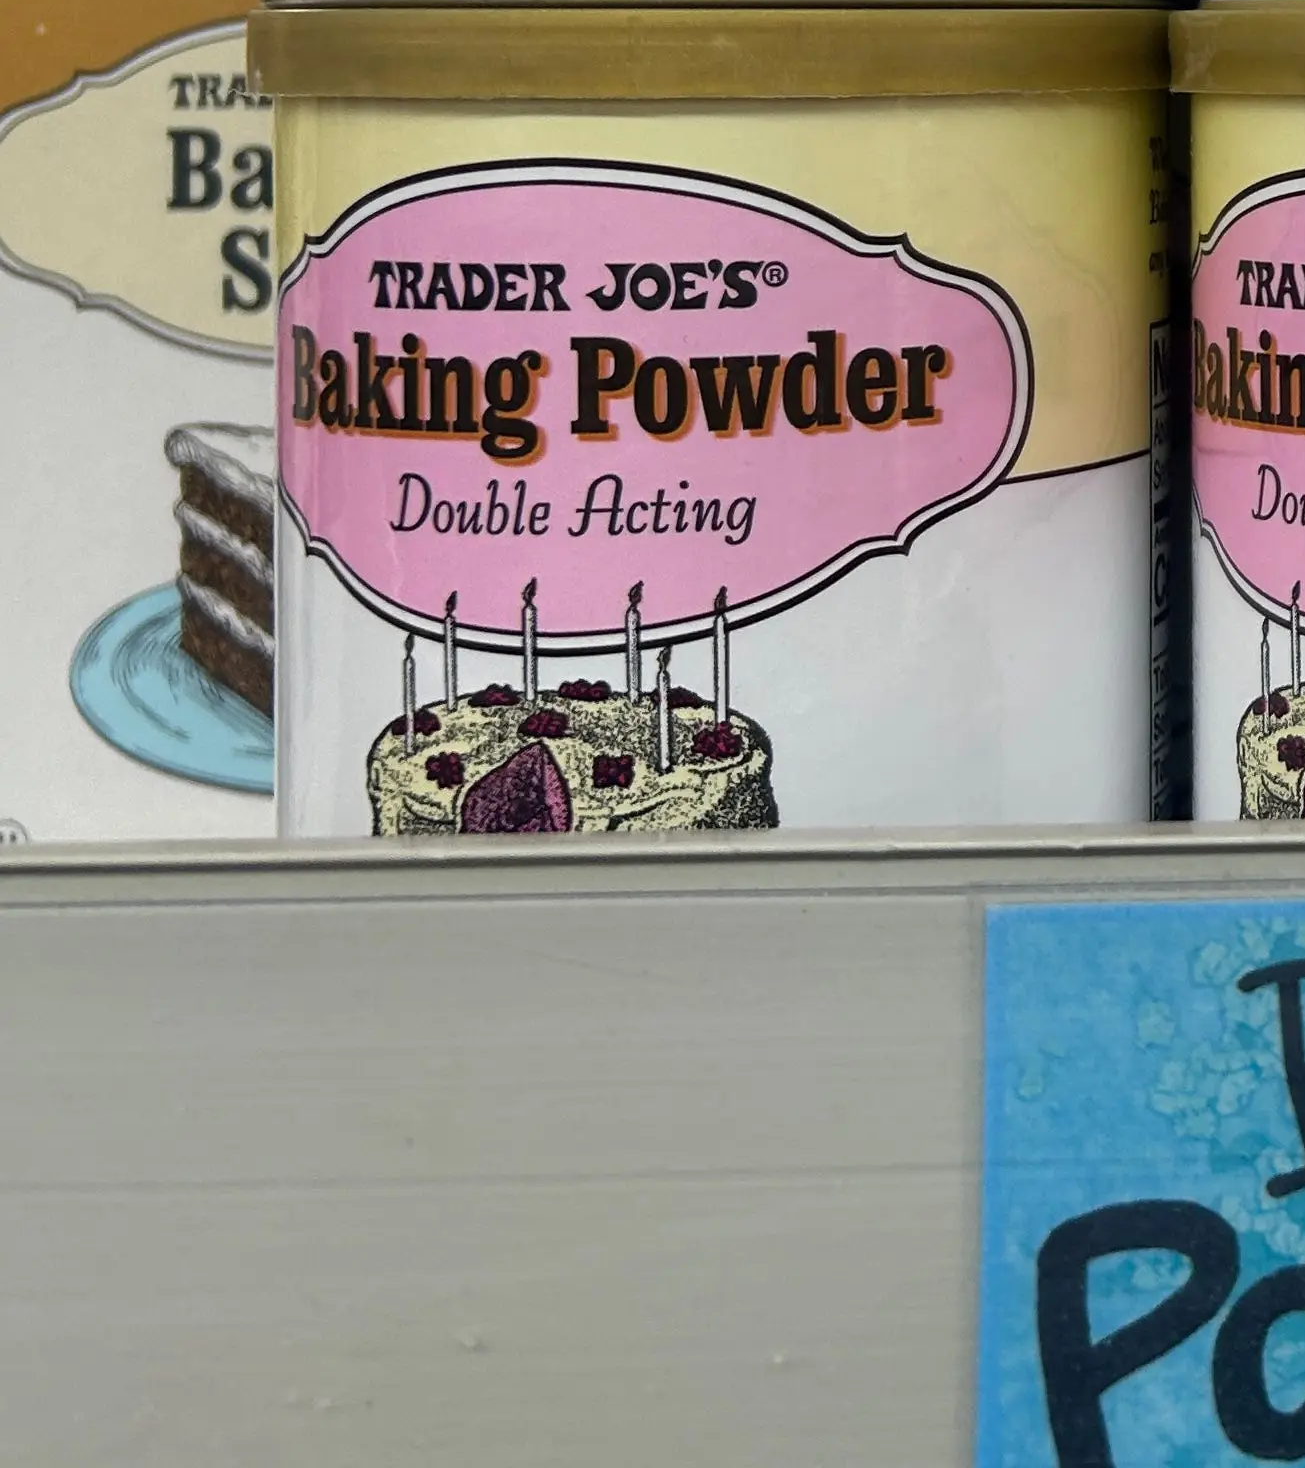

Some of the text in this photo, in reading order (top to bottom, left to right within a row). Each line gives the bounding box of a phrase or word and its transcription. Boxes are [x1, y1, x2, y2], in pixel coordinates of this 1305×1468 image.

[368, 260, 571, 312] TRADER
[291, 323, 952, 468] Baking Powder
[389, 472, 757, 545] Double Acting
